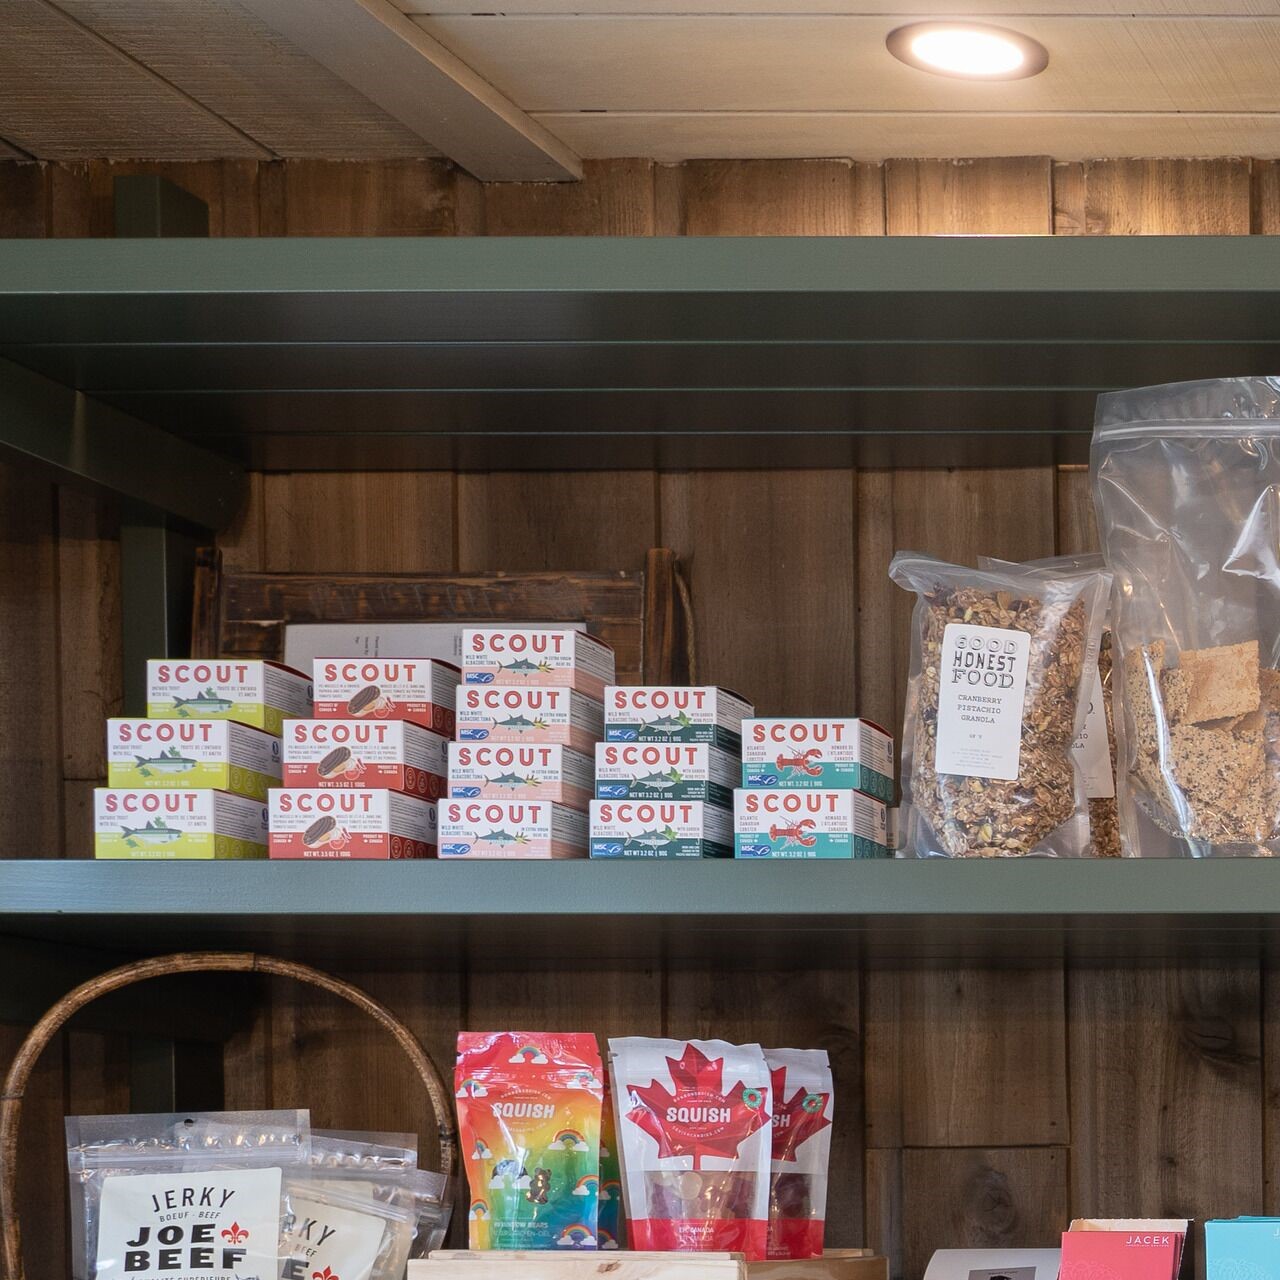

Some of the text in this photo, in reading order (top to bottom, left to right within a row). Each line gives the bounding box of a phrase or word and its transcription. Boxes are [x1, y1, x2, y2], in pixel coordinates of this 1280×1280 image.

[472, 634, 564, 653] SCOUT
[955, 635, 1017, 654] GOOD
[953, 651, 1016, 672] HONEST
[158, 665, 248, 683] SCOUT
[325, 664, 416, 682] SCOUT
[952, 669, 1014, 688] FOOD
[467, 690, 560, 710] SCOUT
[615, 690, 706, 709] SCOUT
[958, 695, 1002, 704] CRANBERRY
[958, 705, 1000, 714] PISTACHIO
[961, 715, 995, 724] GRANOLA
[119, 723, 212, 742] SCOUT
[295, 724, 387, 743] SCOUT
[753, 724, 845, 743] SCOUT
[459, 747, 551, 767] SCOUT
[606, 747, 697, 766] SCOUT
[106, 794, 198, 812] SCOUT
[280, 793, 372, 812] SCOUT
[746, 794, 838, 813] SCOUT
[449, 805, 541, 825] SCOUT
[601, 805, 692, 823] SCOUT
[492, 1102, 555, 1119] SQUISH
[666, 1107, 730, 1123] SQUISH
[152, 1187, 235, 1212] JERKY
[126, 1224, 216, 1247] JOE
[1126, 1236, 1169, 1244] JACEK
[124, 1248, 246, 1272] BEEF
